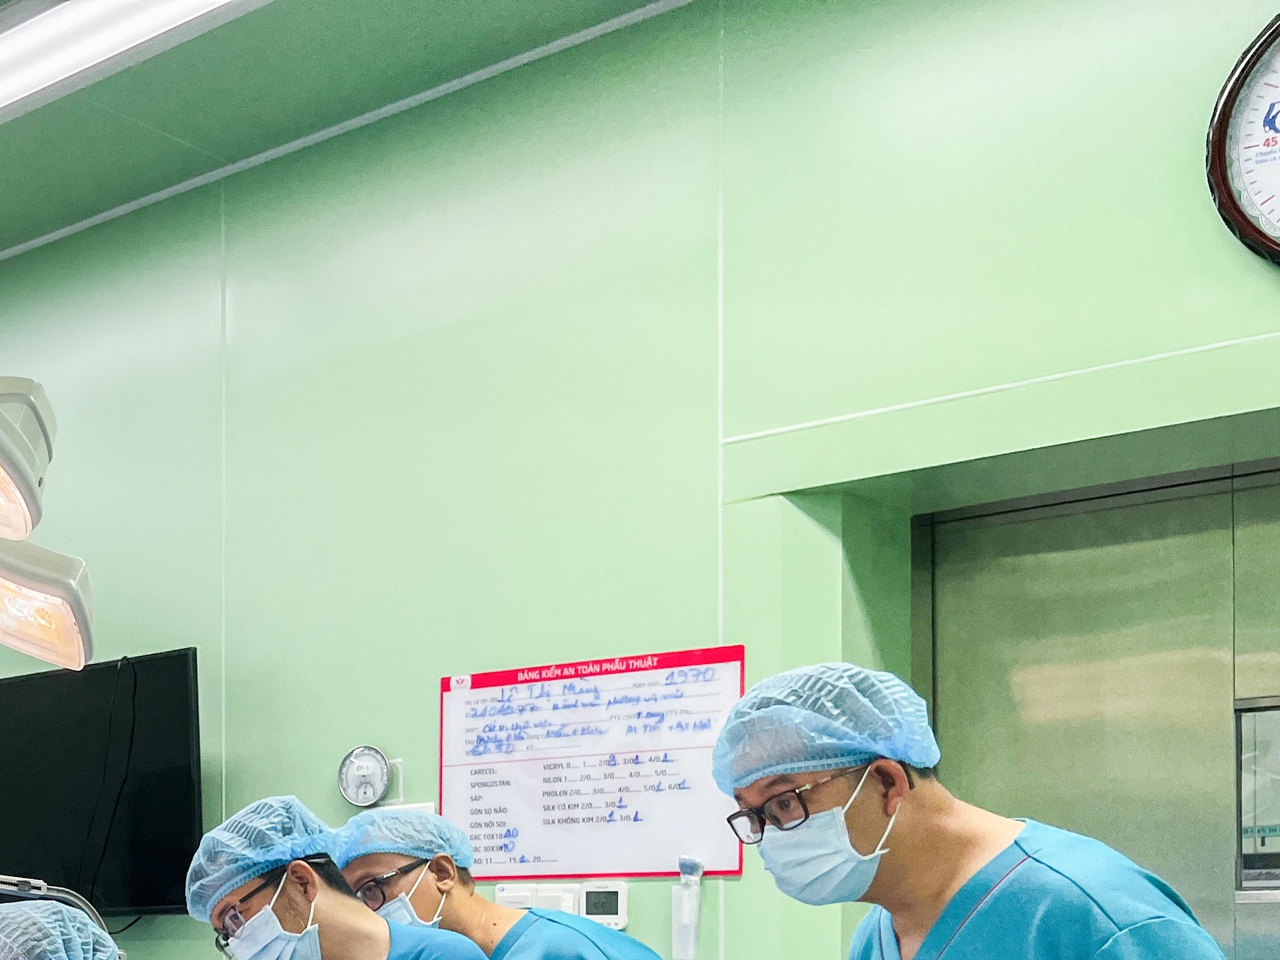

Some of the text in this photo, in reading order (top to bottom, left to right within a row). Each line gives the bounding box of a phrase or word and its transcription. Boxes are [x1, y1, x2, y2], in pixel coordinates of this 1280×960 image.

[1263, 136, 1278, 148] 45
[563, 667, 575, 676] AN
[665, 667, 715, 686] 1970
